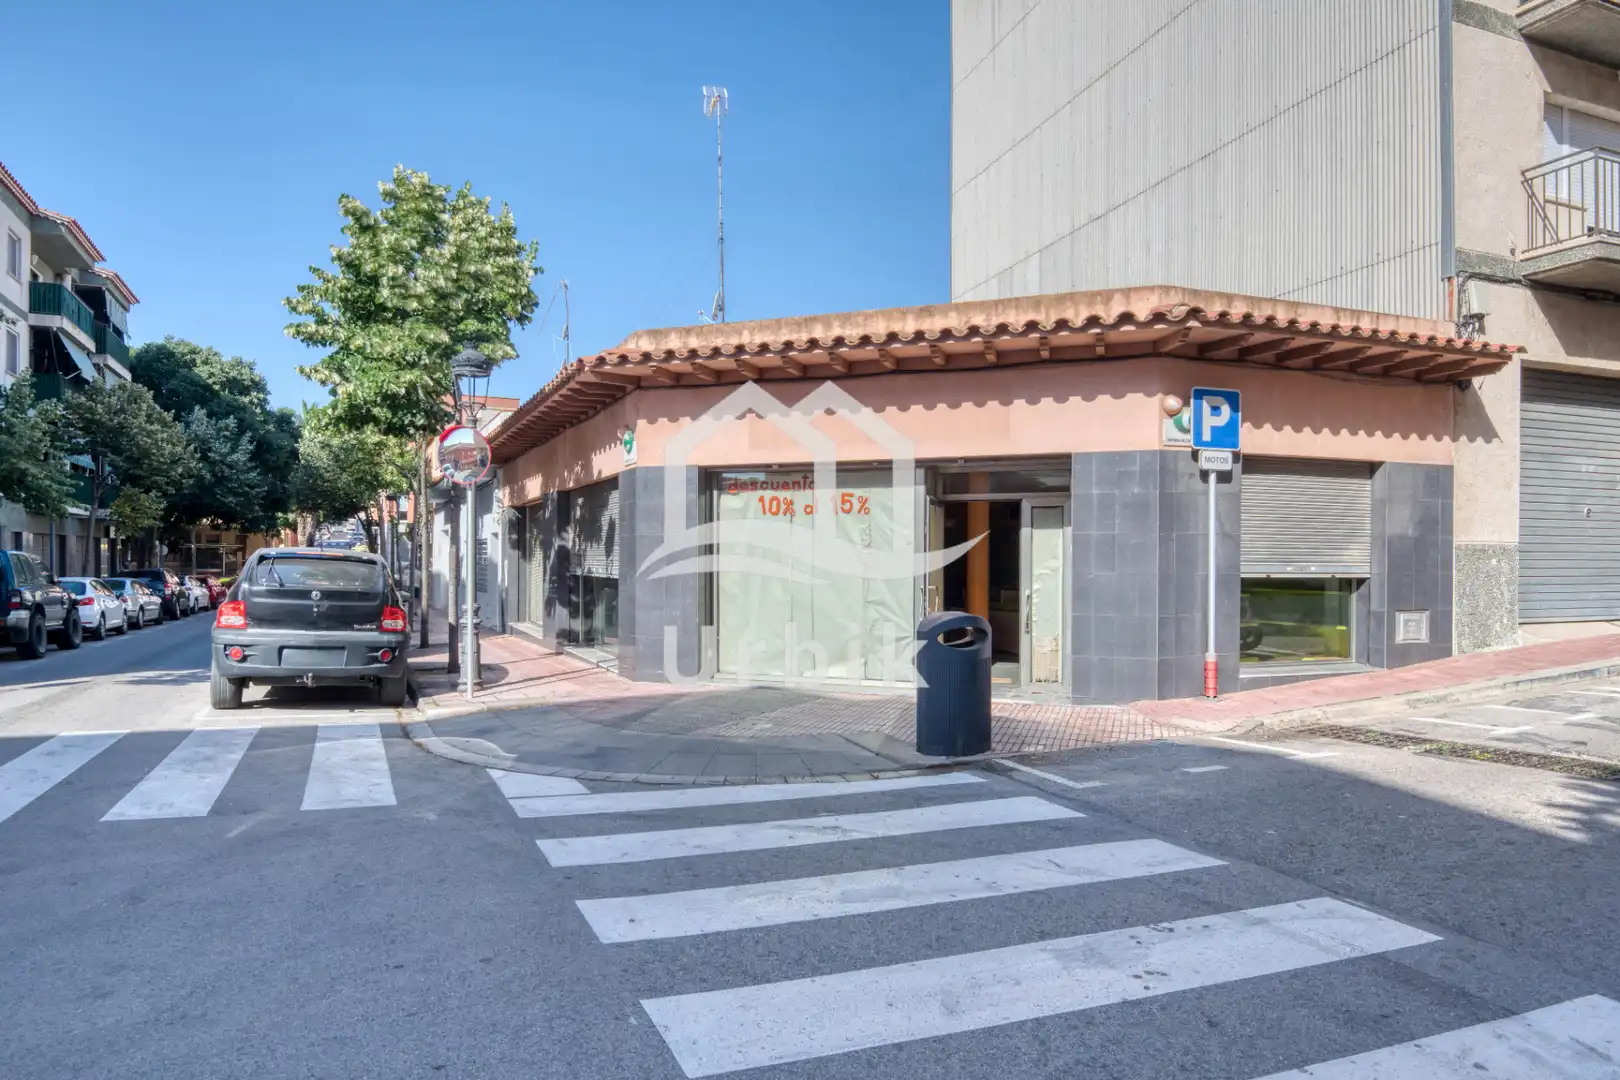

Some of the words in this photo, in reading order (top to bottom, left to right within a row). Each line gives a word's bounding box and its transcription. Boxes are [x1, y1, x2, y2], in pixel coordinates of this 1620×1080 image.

[1202, 396, 1230, 441] P
[1204, 455, 1229, 464] MOTOS
[757, 495, 796, 517] 10%
